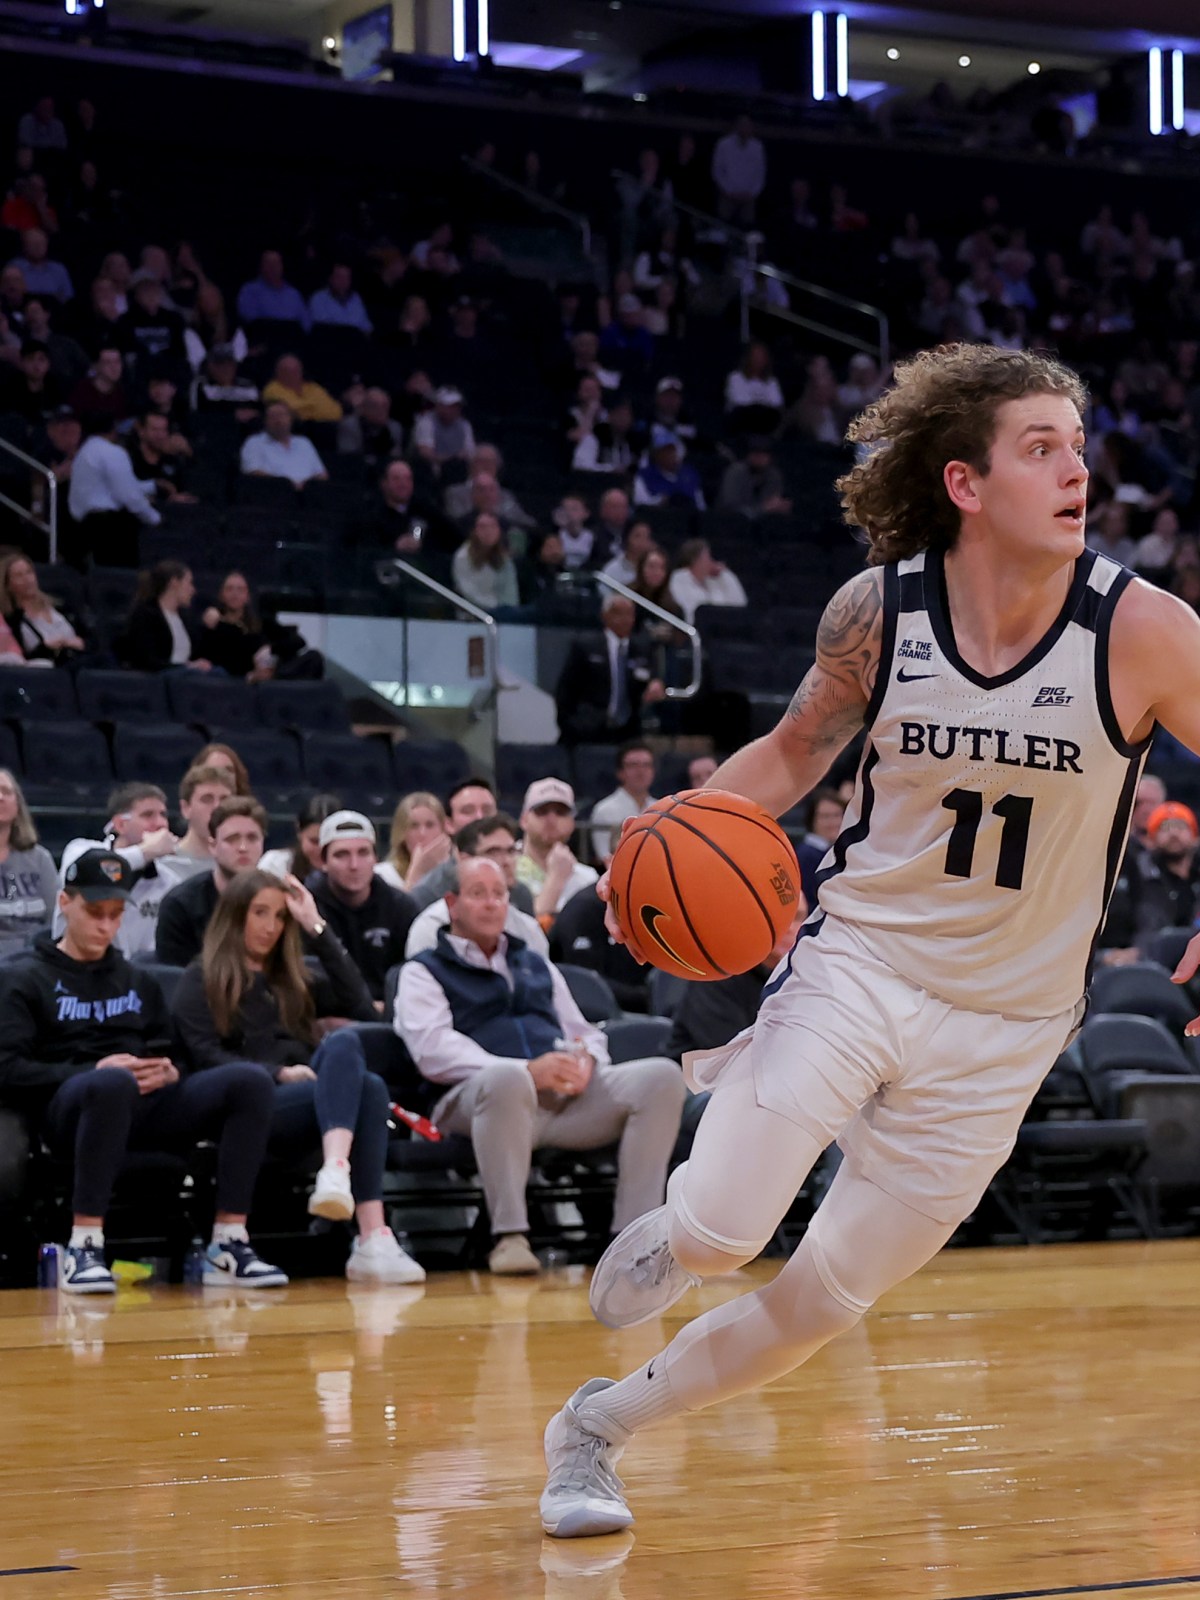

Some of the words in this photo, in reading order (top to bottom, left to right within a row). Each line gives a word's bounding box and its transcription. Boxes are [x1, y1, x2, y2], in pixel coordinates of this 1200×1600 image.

[901, 639, 913, 649] BE
[915, 641, 932, 652] THE
[897, 648, 932, 660] CHANGE
[1038, 686, 1067, 696] BIG
[1033, 695, 1074, 704] EAST
[900, 722, 1083, 774] BUTLER
[942, 787, 1034, 890] 11
